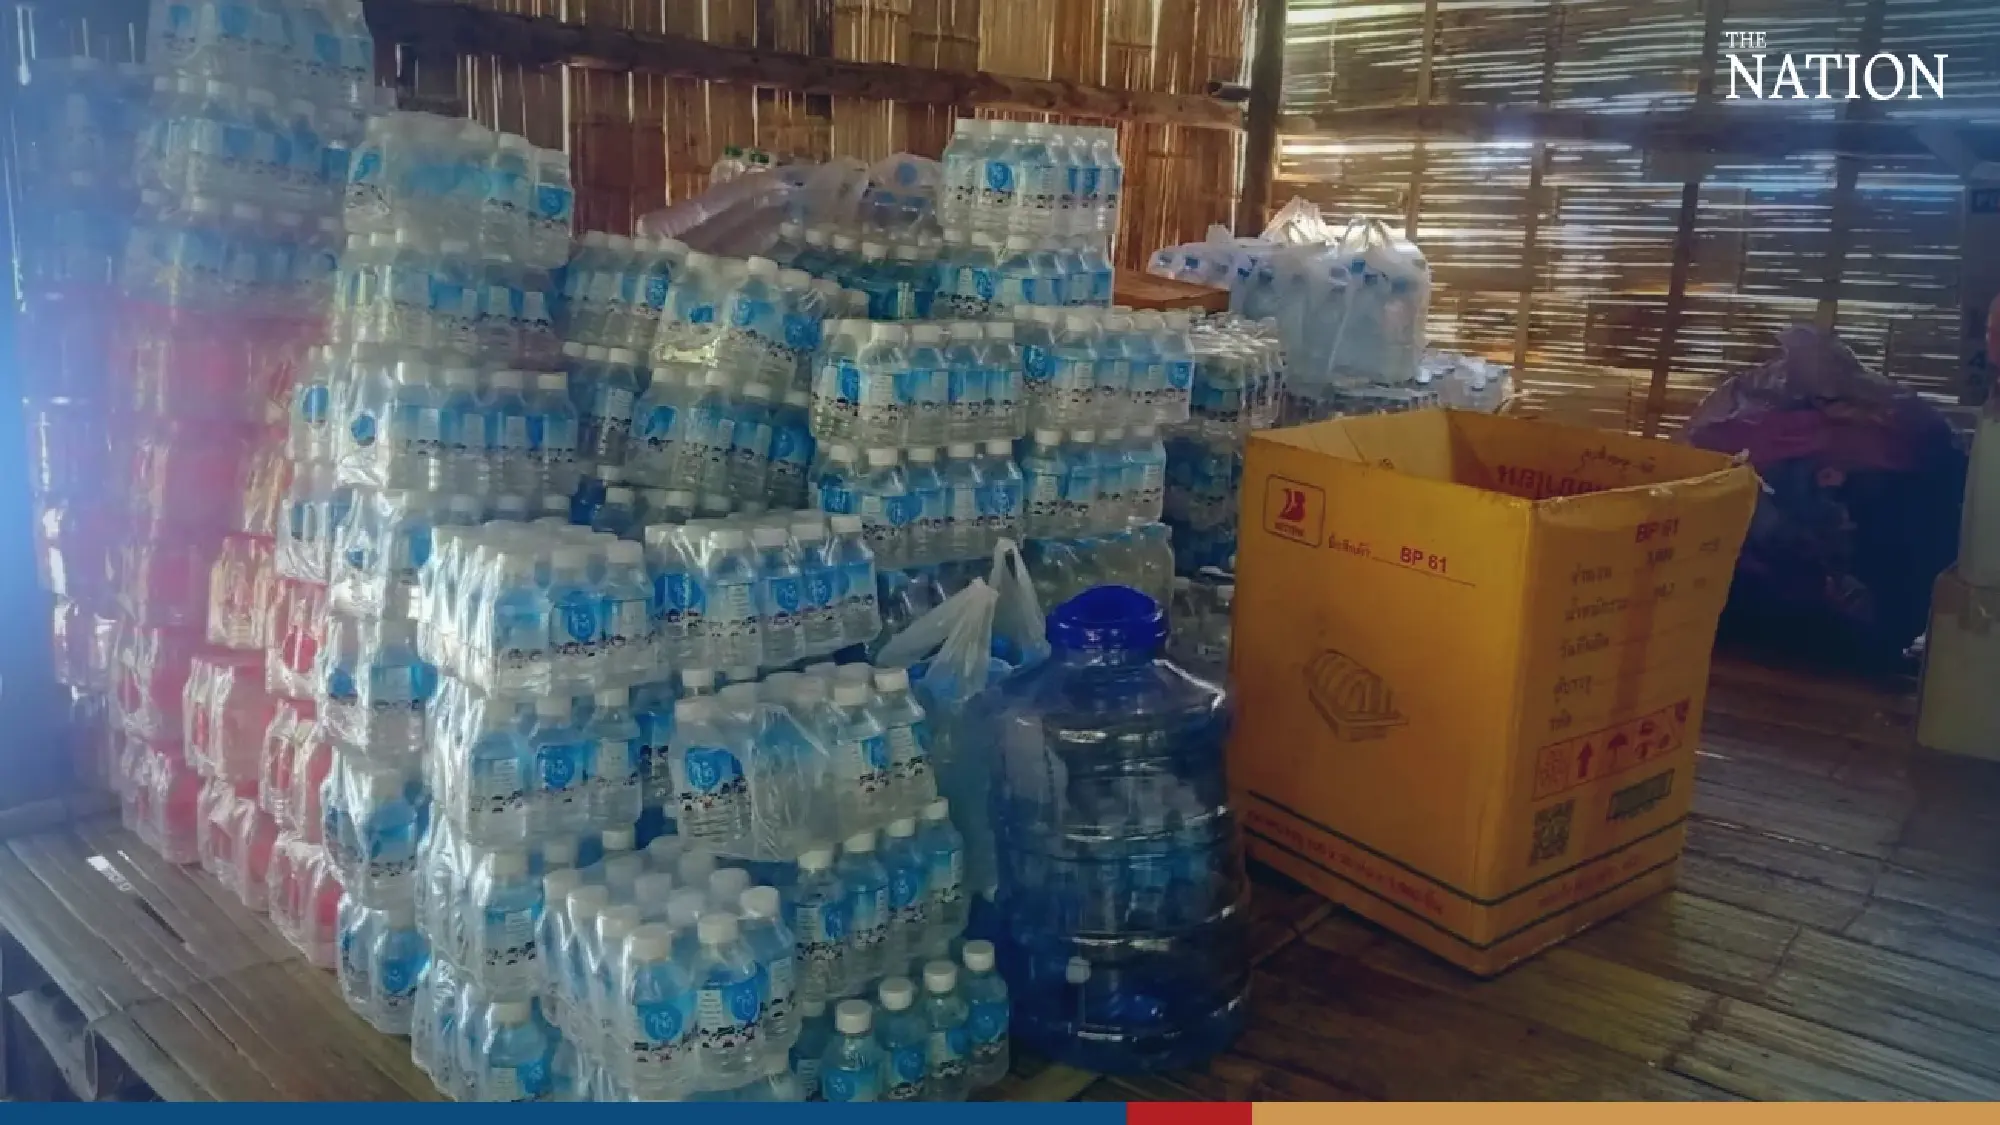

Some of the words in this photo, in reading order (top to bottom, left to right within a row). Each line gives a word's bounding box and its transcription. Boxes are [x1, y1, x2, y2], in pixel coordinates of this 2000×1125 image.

[1635, 523, 1659, 544] BP
[1400, 546, 1424, 565] BP
[1428, 554, 1447, 573] 61
